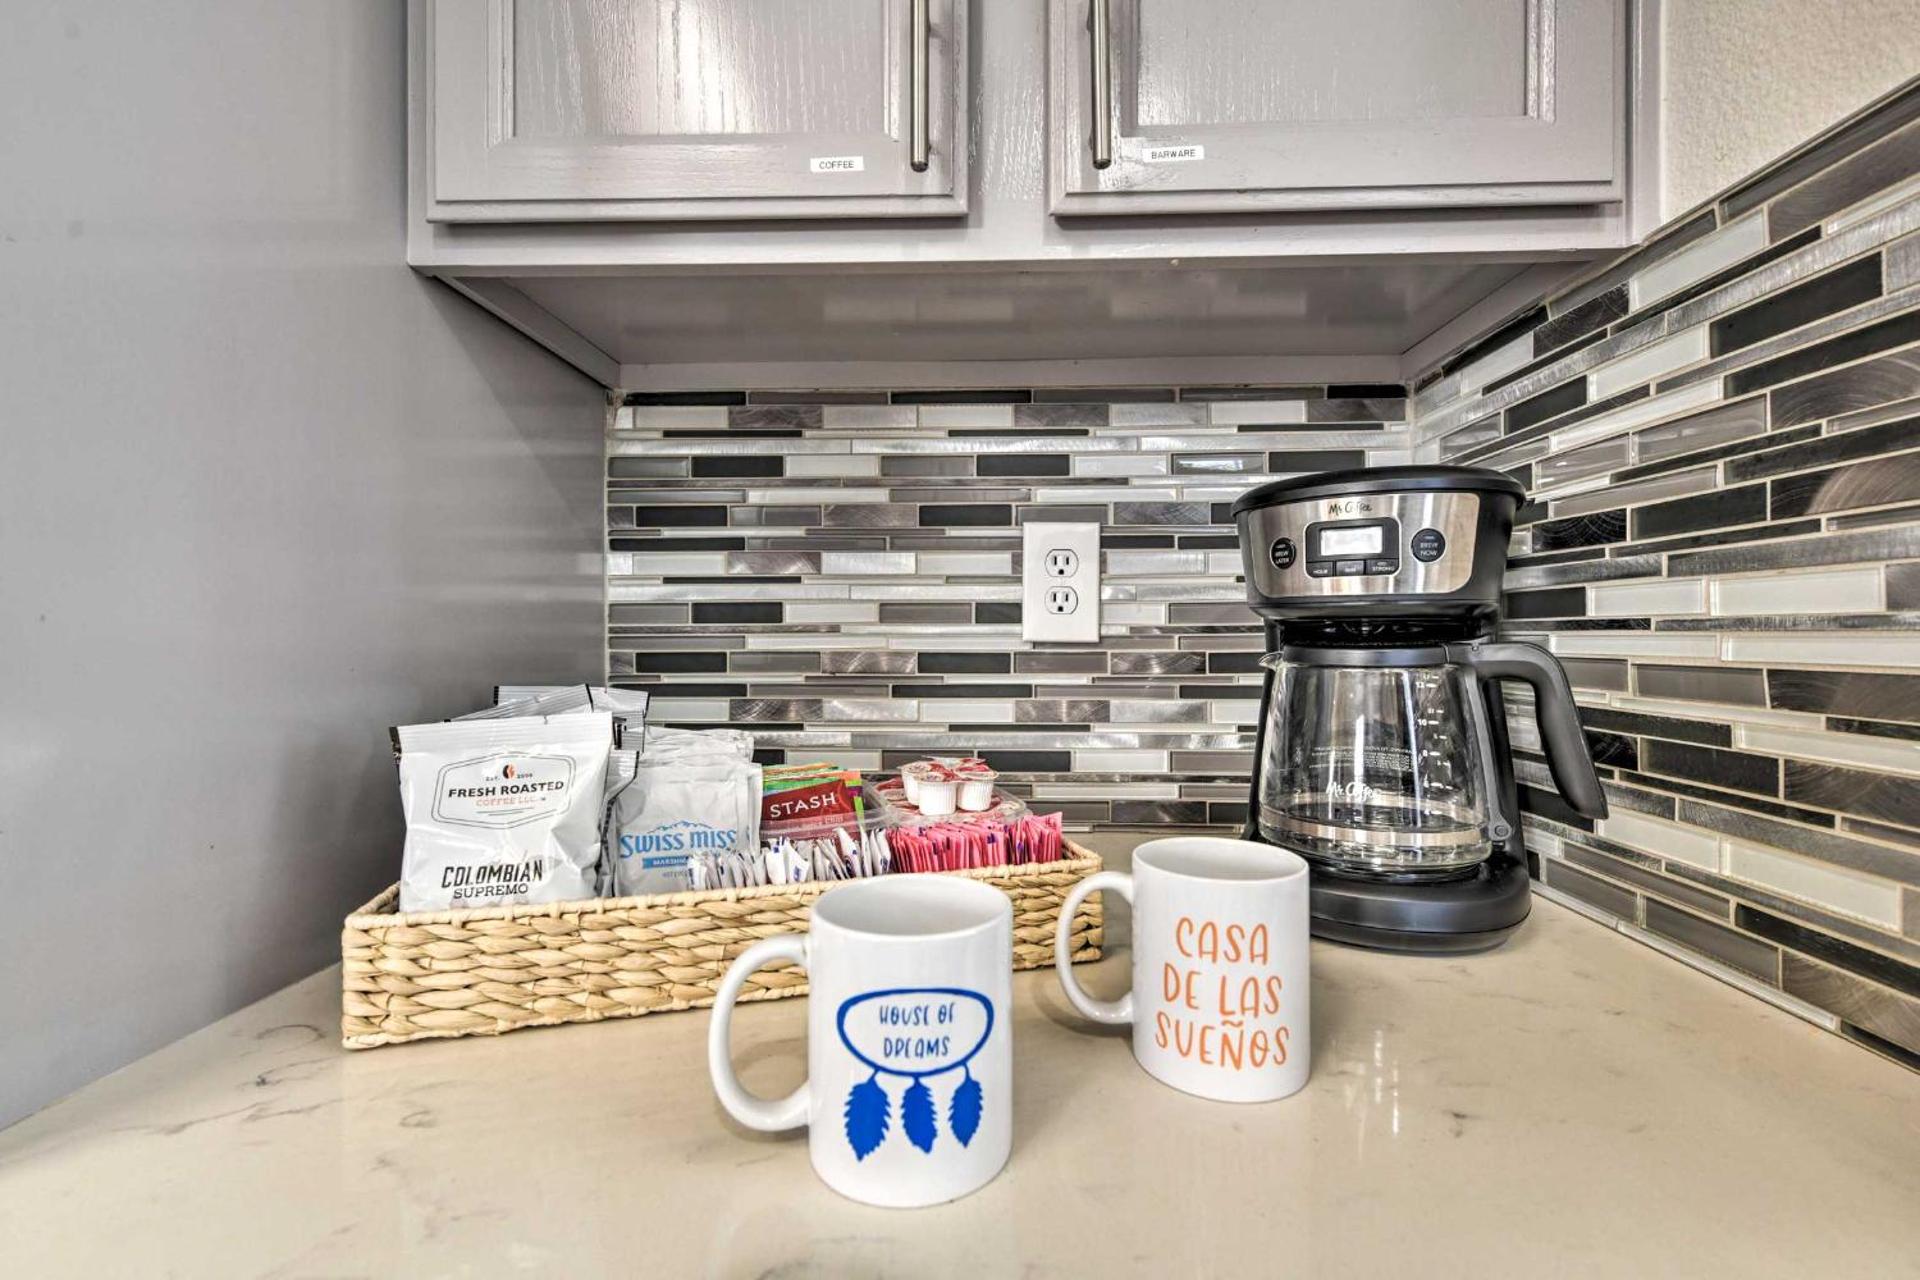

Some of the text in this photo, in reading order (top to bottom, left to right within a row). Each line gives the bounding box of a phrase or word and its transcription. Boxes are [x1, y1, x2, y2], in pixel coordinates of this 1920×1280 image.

[819, 160, 855, 170] COFFEE
[1151, 149, 1196, 160] BARWARE
[448, 780, 564, 798] FRESH ROASTED
[770, 791, 837, 818] STASH
[619, 829, 737, 859] SWISS MISS
[441, 859, 544, 889] COLOMBIAN
[453, 882, 529, 899] SUPREMO
[1176, 916, 1268, 966] CASA
[1164, 962, 1283, 1019] DE LAS
[879, 1002, 955, 1026] HOUSE OF
[883, 1036, 951, 1059] DREAMS
[1155, 1011, 1290, 1071] SUEÑOS
